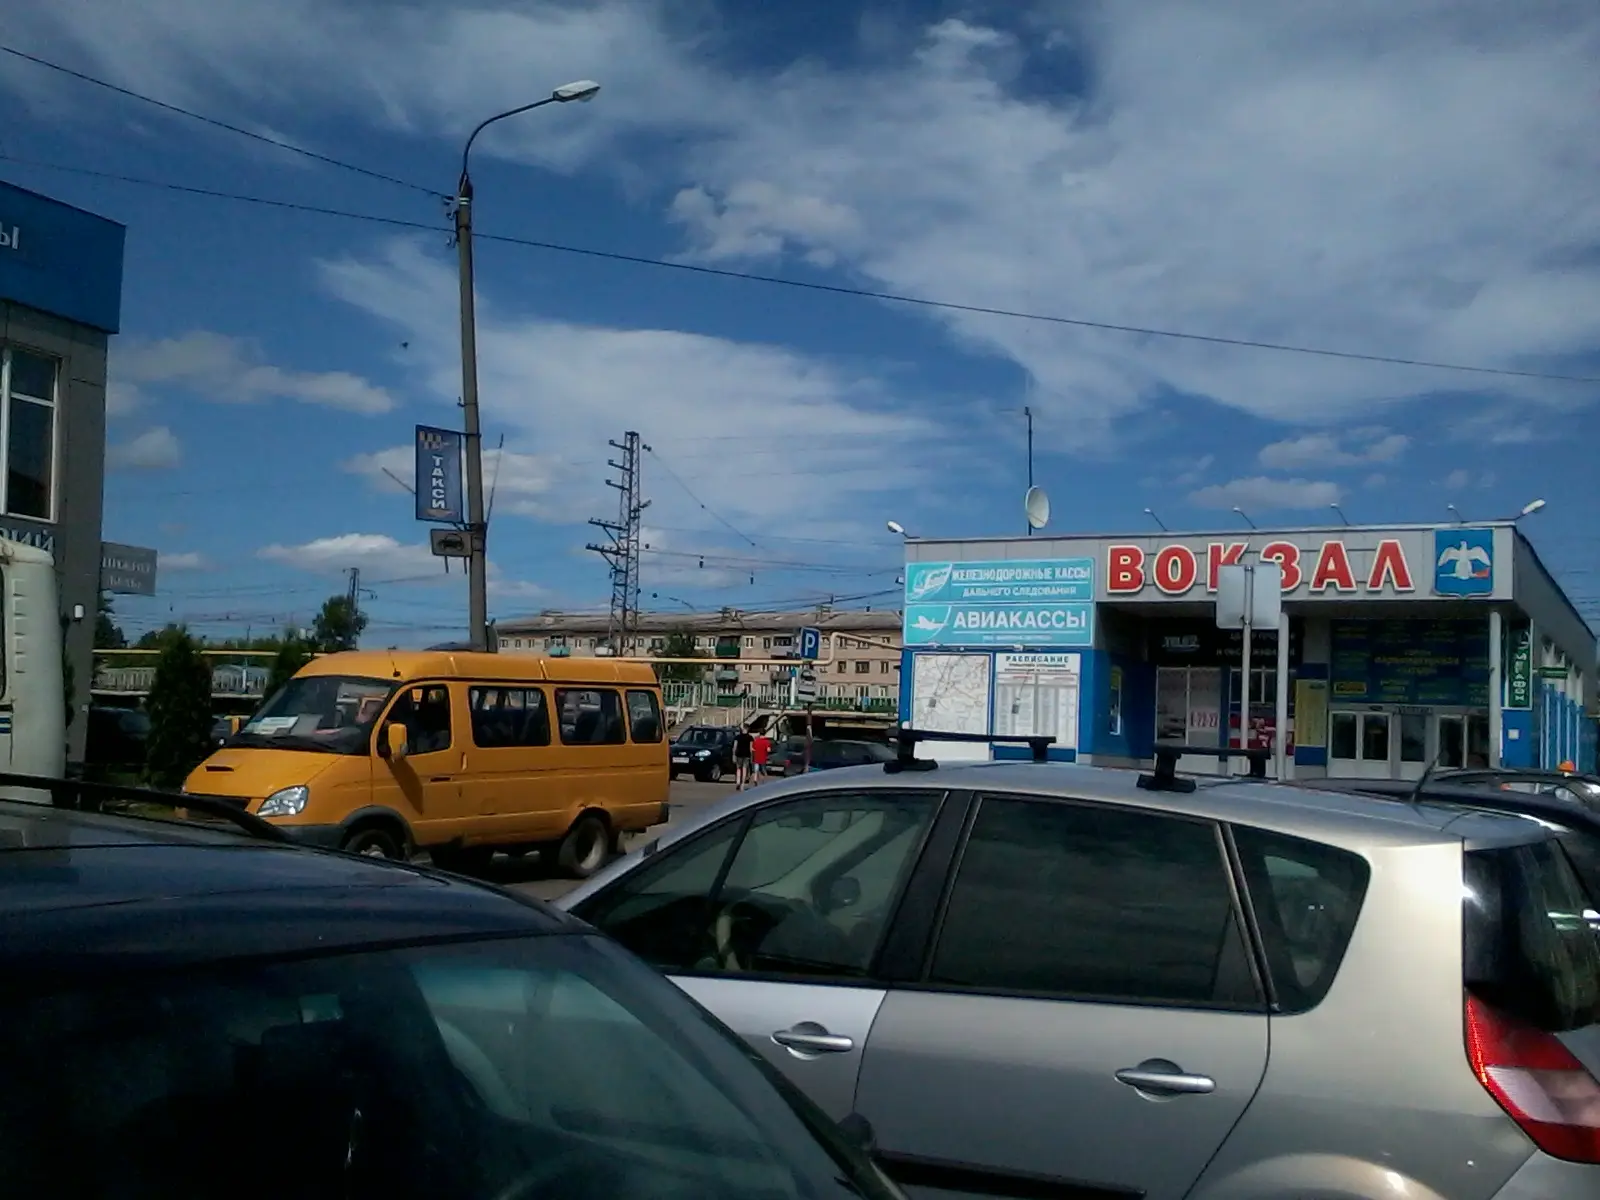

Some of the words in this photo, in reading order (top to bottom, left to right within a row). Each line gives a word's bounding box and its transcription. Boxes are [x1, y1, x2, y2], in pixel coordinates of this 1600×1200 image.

[431, 454, 446, 509] ТАКСИ
[952, 567, 1052, 582] ЖЕЛЕЗНОДОРОЖНЫЕ
[1054, 566, 1091, 579] КАССЫ
[1107, 539, 1416, 595] ВОКЗАЛ
[953, 610, 1086, 629] АВИАКАССЫ
[1006, 655, 1069, 664] РАСПИСАНИЕ
